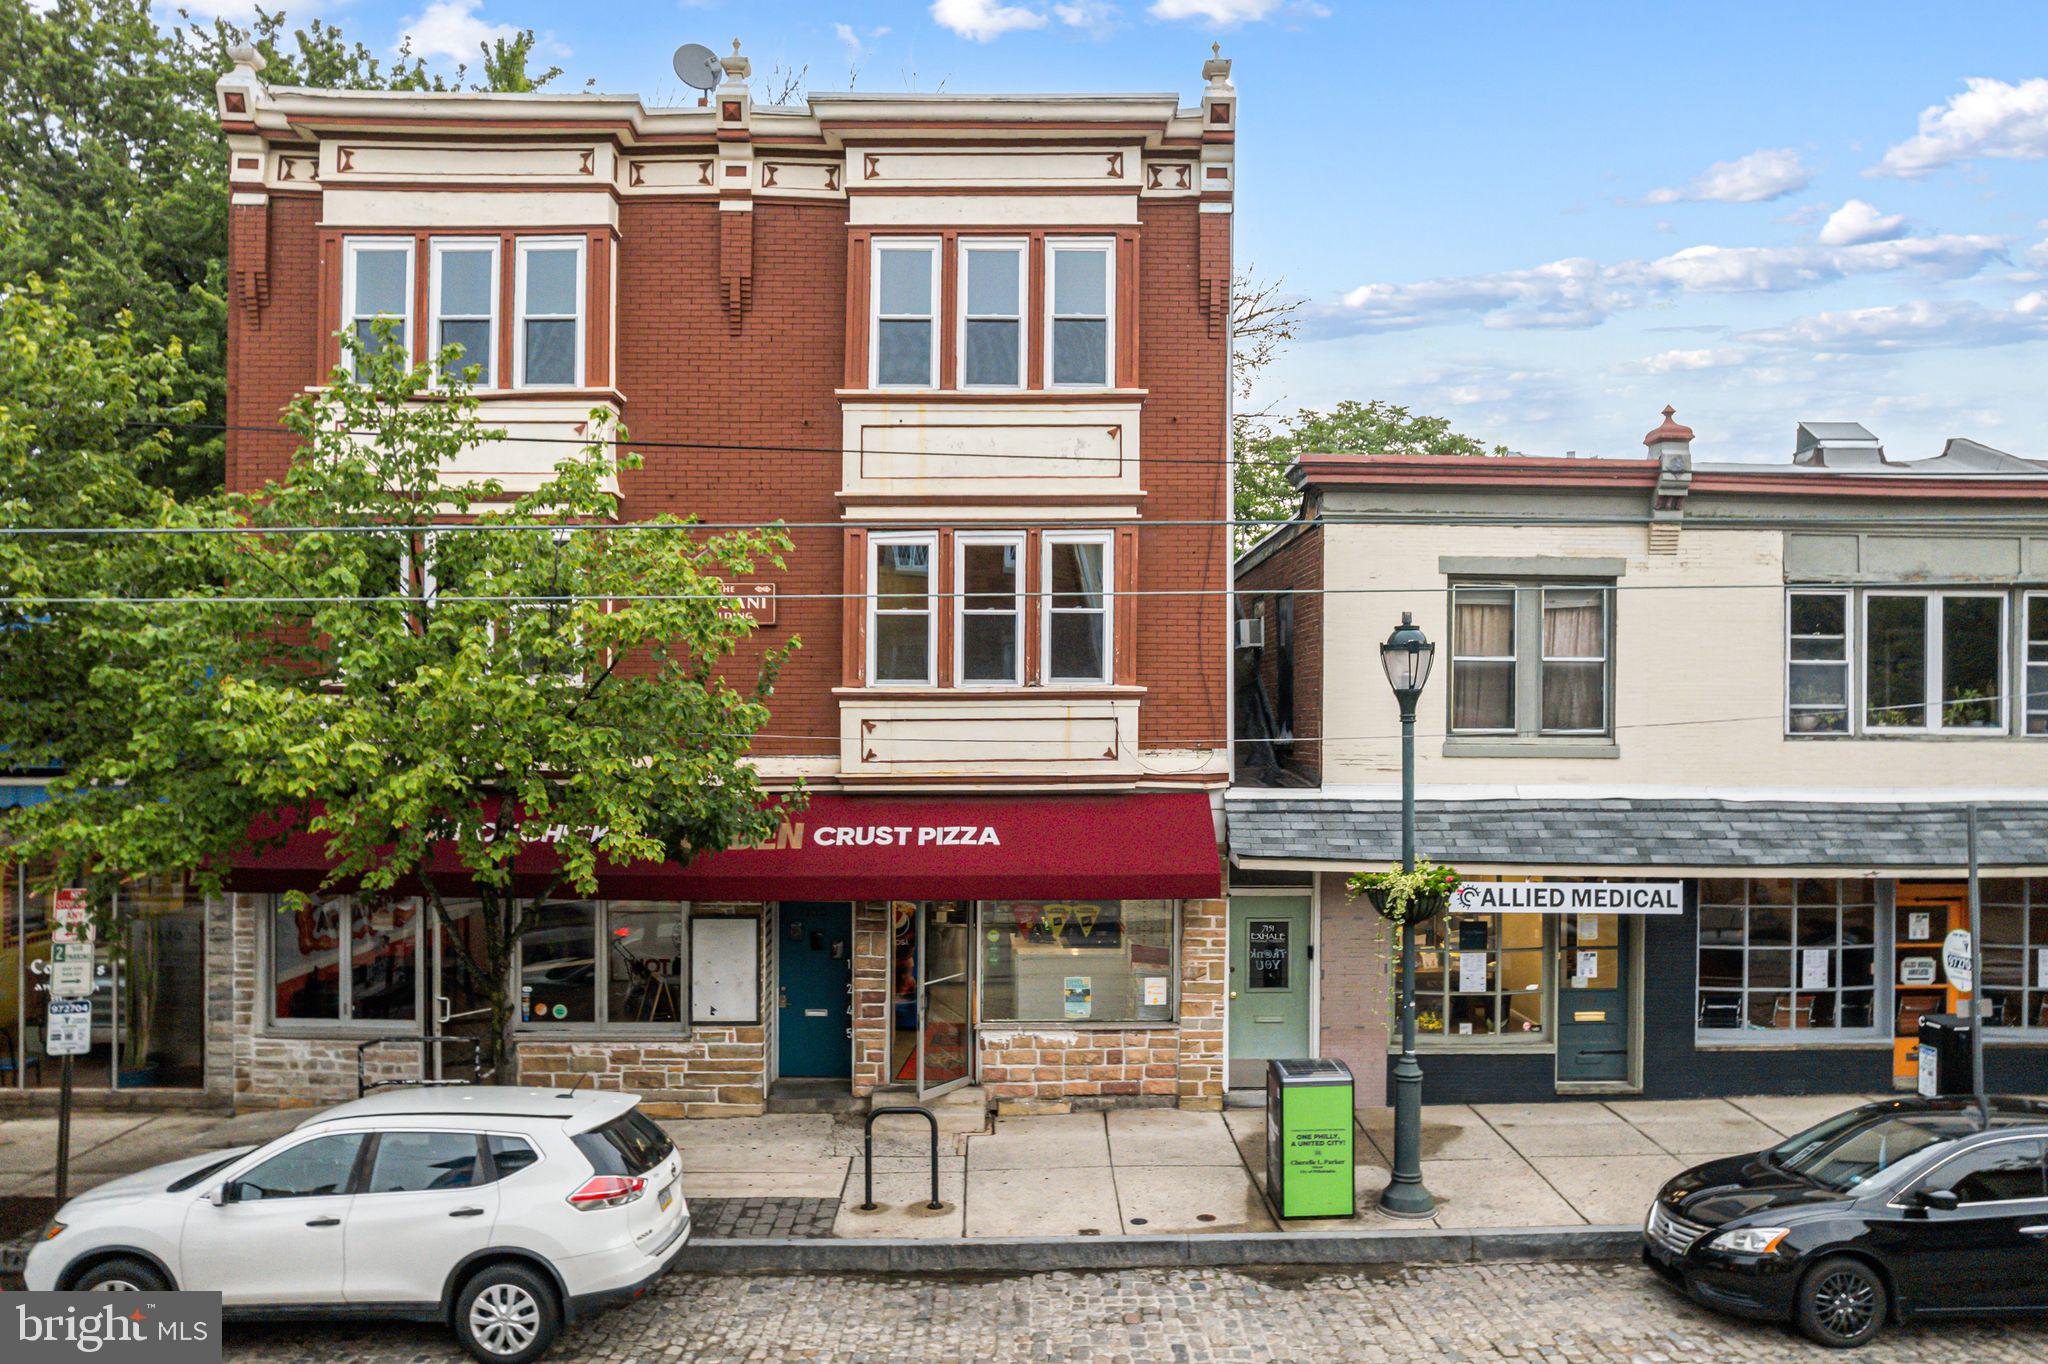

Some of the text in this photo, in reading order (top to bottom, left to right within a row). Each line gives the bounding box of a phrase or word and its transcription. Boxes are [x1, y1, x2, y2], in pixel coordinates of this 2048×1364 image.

[813, 826, 912, 846] CRUST
[917, 826, 1001, 846] PIZZA
[1480, 887, 1679, 908] ALLIED MEDICAL
[1250, 932, 1286, 940] EXHALE
[54, 946, 64, 960] 2
